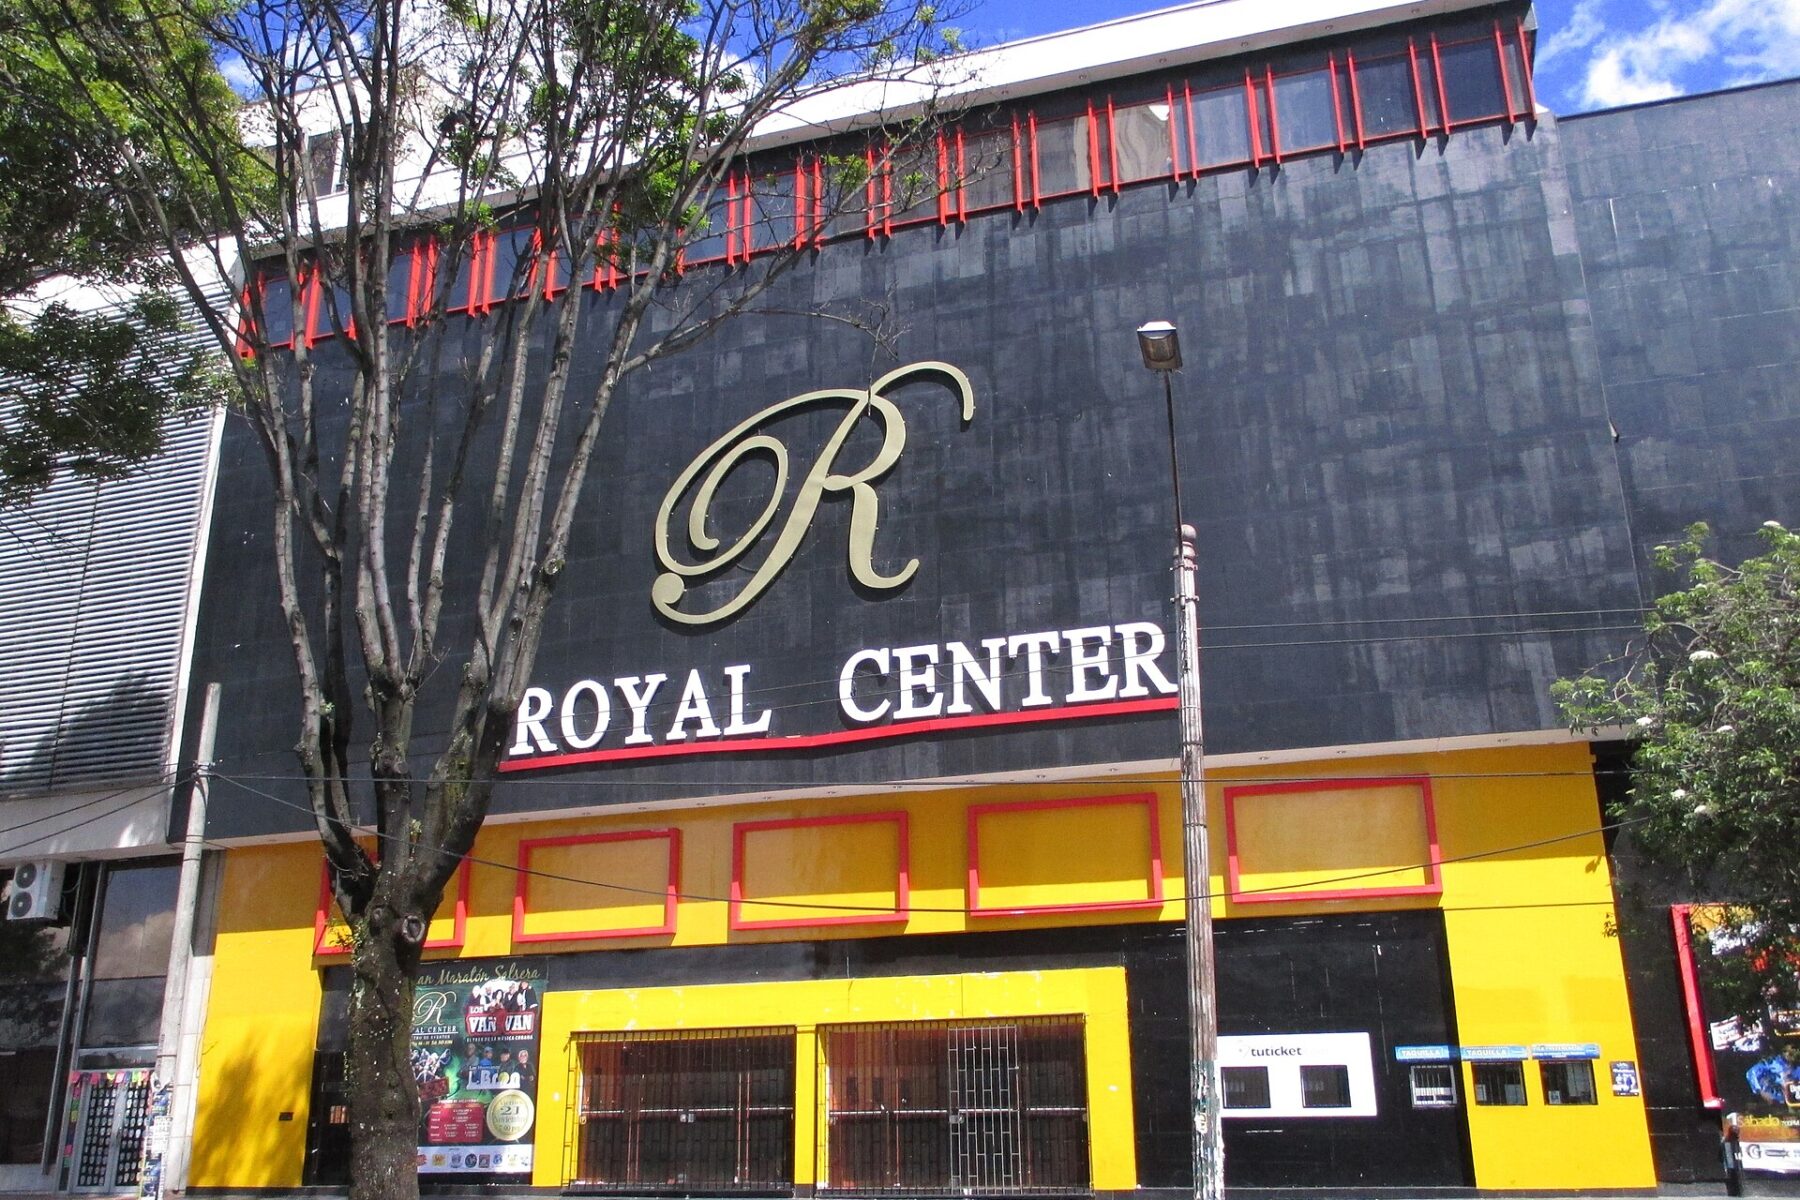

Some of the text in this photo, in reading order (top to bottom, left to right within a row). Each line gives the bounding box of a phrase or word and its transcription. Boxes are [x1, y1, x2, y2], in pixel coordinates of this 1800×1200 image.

[652, 361, 974, 624] R
[508, 621, 1178, 757] ROYAL CENTER
[469, 1005, 484, 1014] LOS
[468, 1013, 533, 1033] VAN VAN
[1250, 1046, 1302, 1057] tuticket
[1466, 1049, 1507, 1057] TAQUILLA
